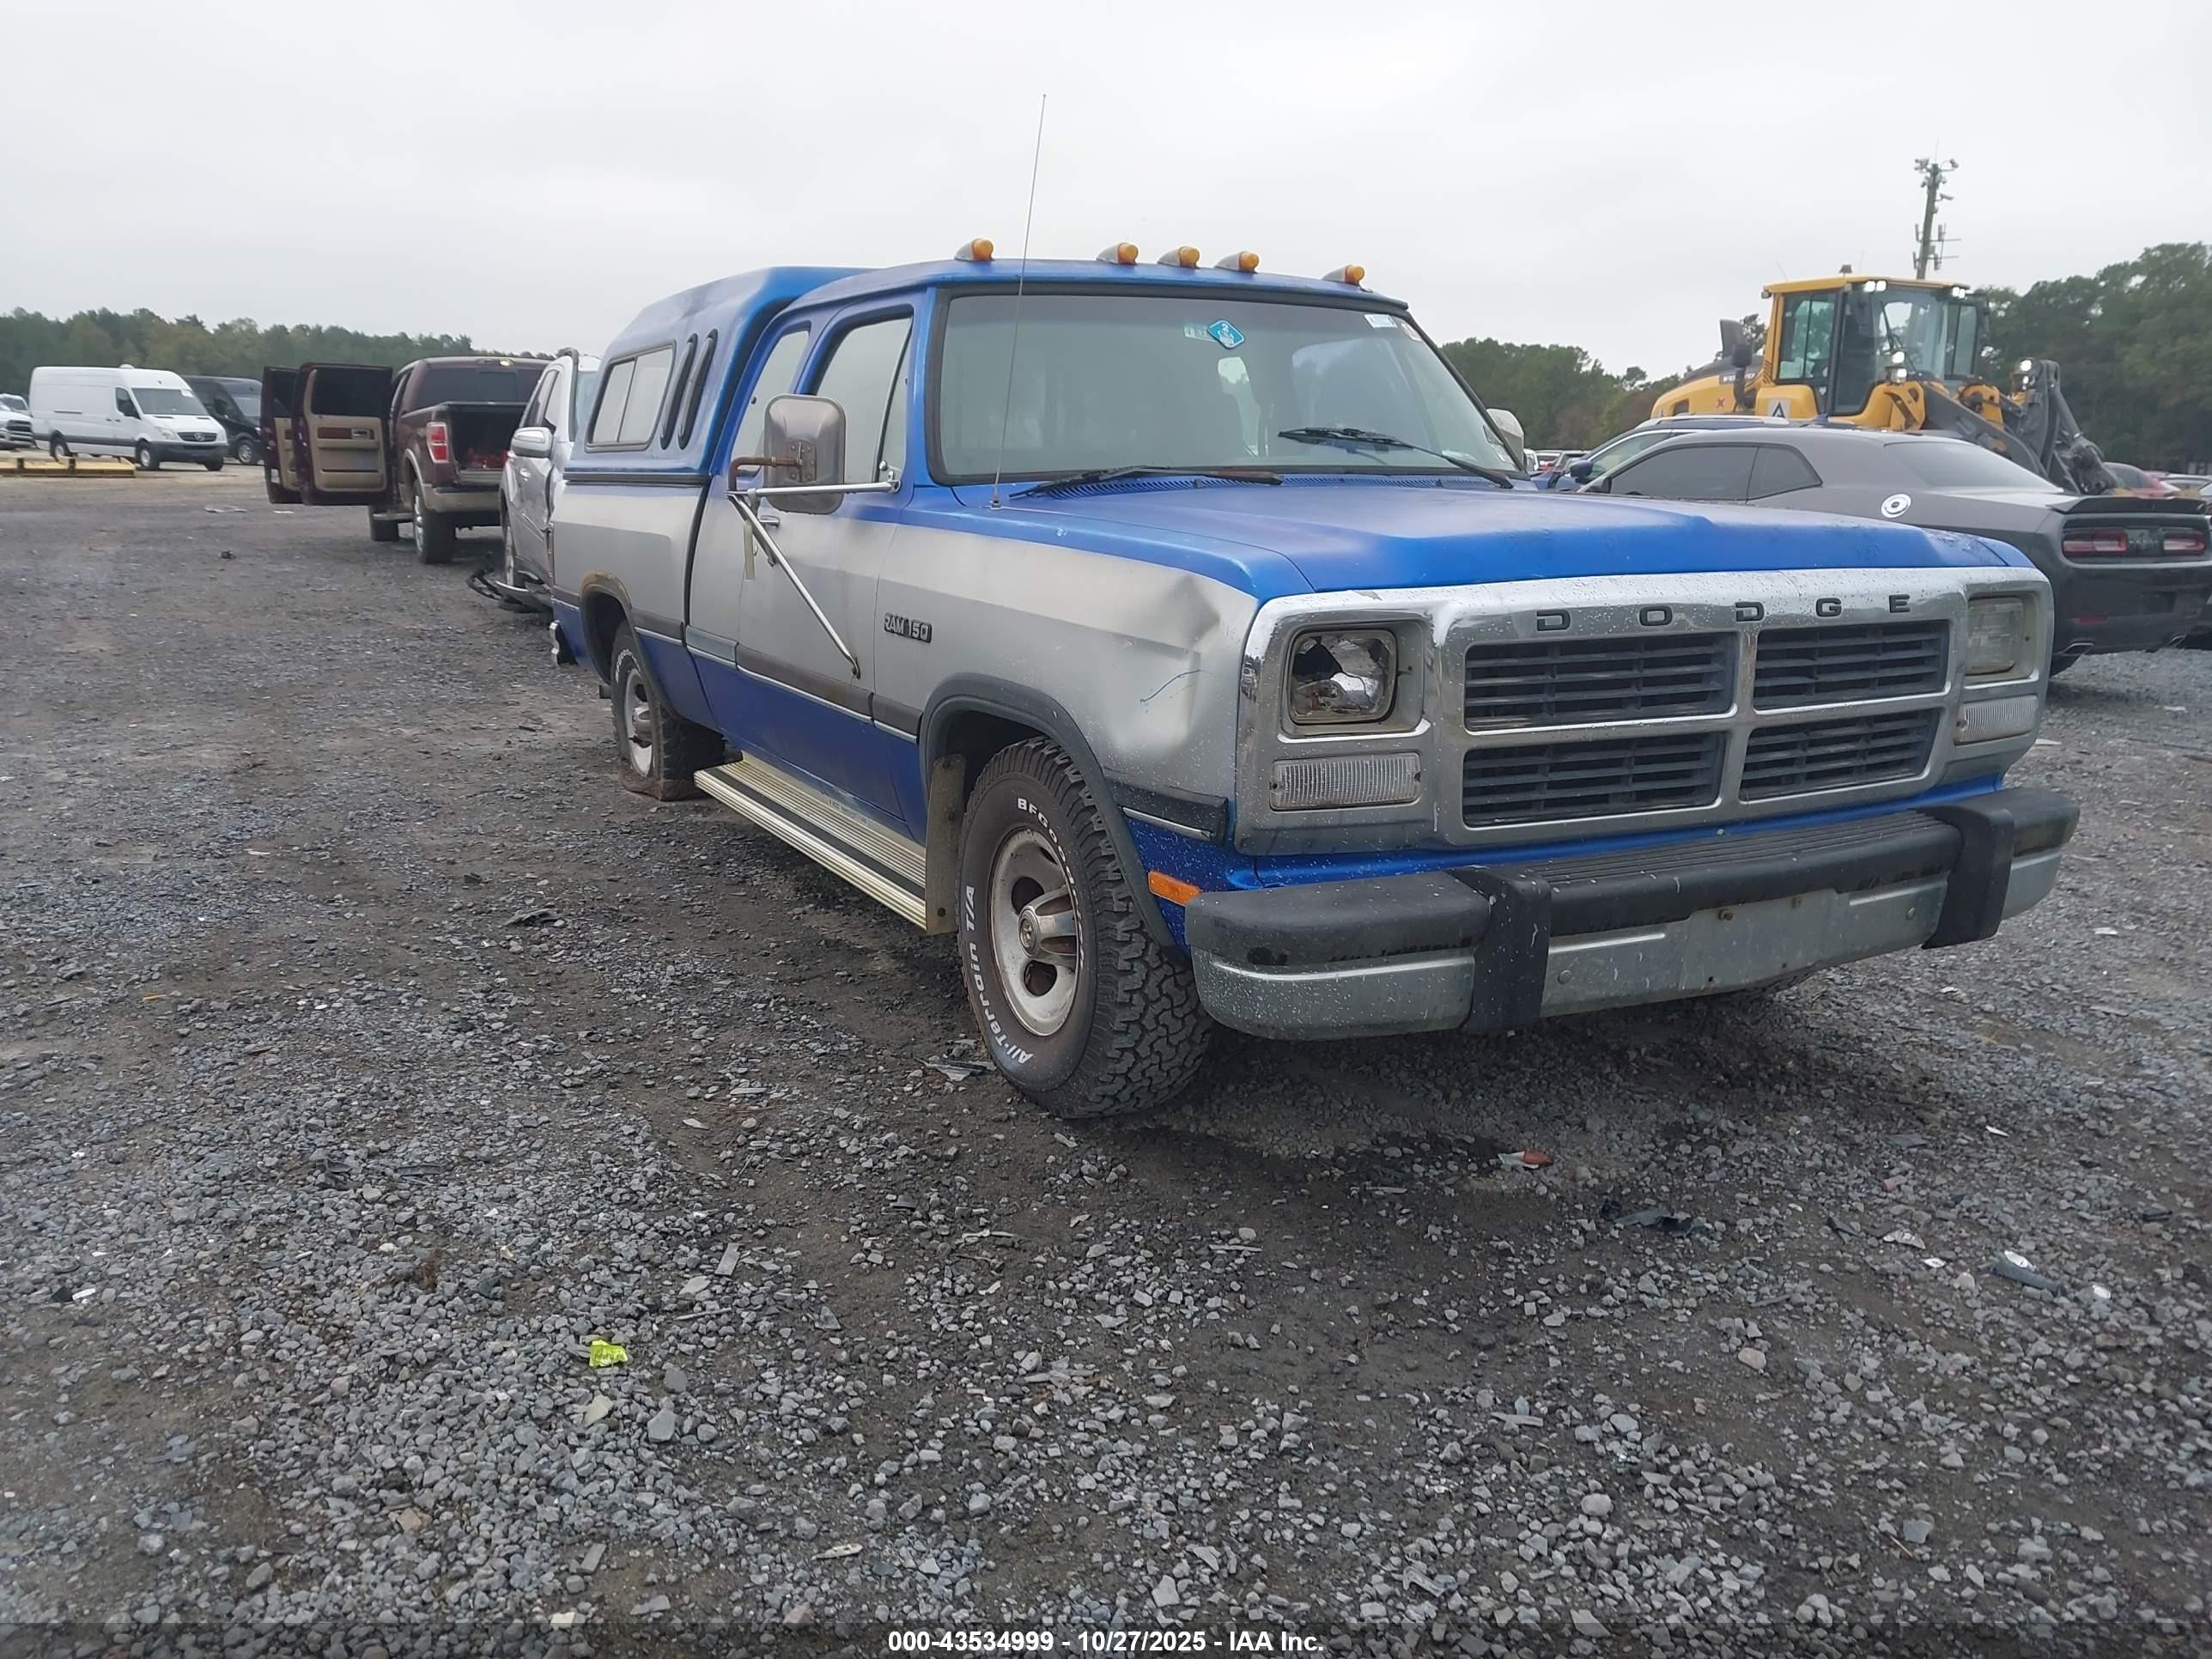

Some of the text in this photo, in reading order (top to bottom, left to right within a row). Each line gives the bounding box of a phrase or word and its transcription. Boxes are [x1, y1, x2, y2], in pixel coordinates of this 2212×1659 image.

[884, 615, 929, 641] RAM 150
[1536, 593, 1911, 632] DODGE
[965, 885, 975, 933] T/A
